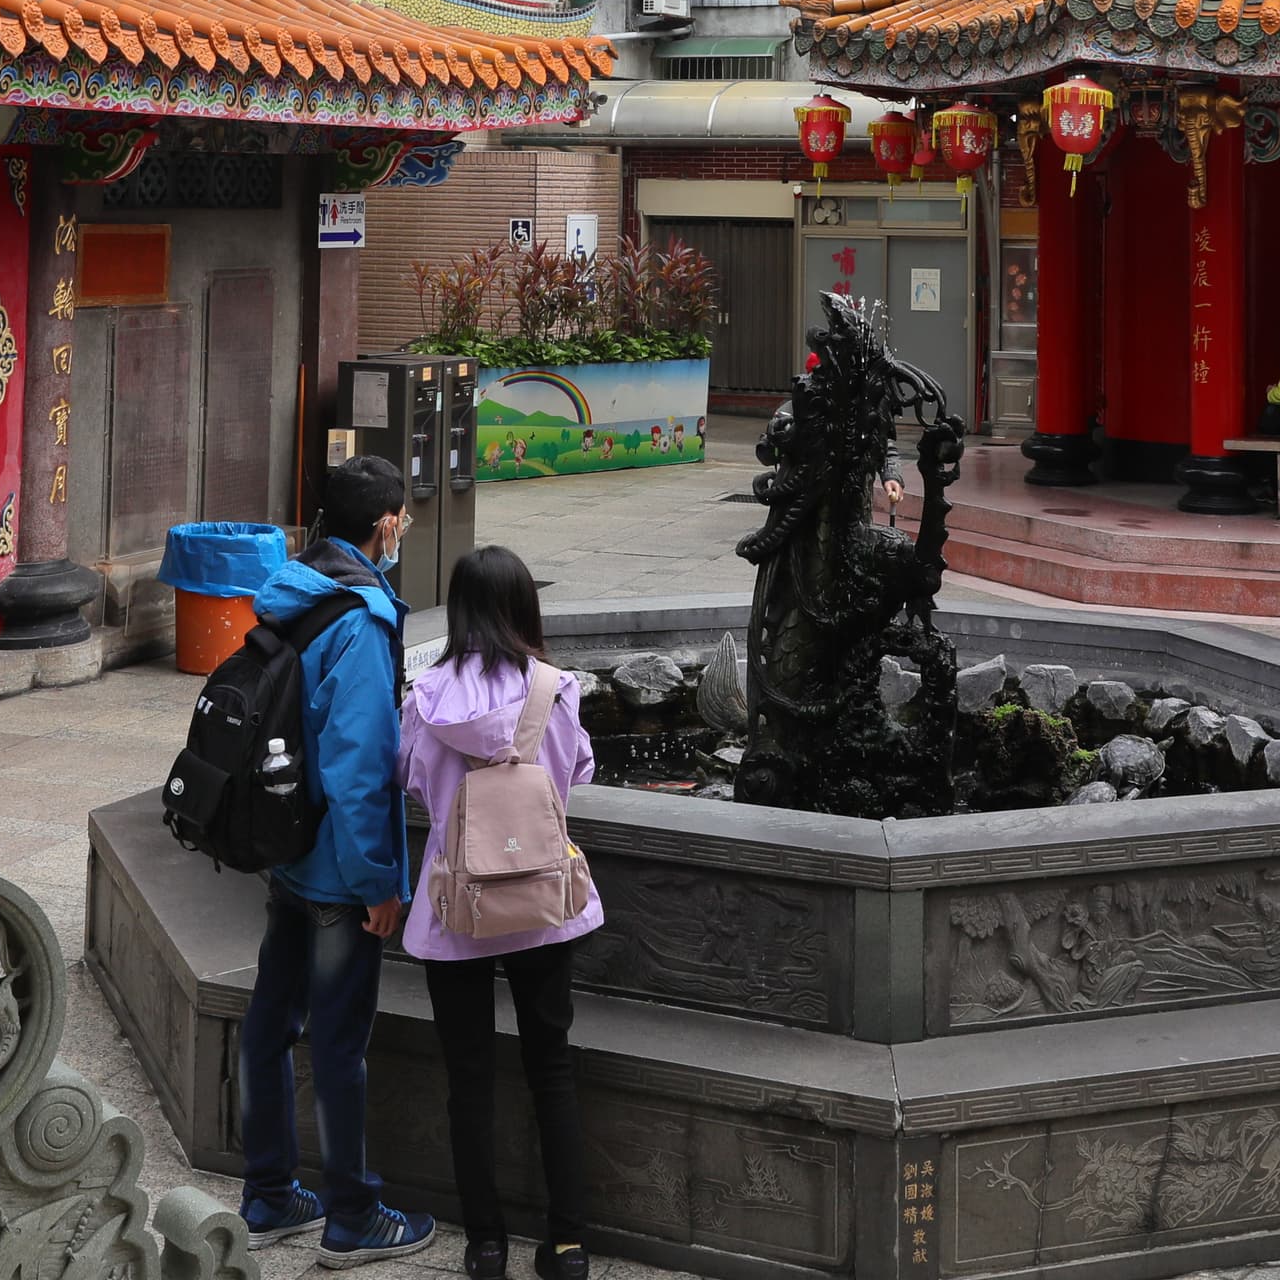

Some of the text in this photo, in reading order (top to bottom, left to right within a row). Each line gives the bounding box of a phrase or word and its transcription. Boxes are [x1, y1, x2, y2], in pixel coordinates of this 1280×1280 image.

[339, 200, 365, 215] 洗手間
[1191, 227, 1217, 385] 凌晨一杵鐘
